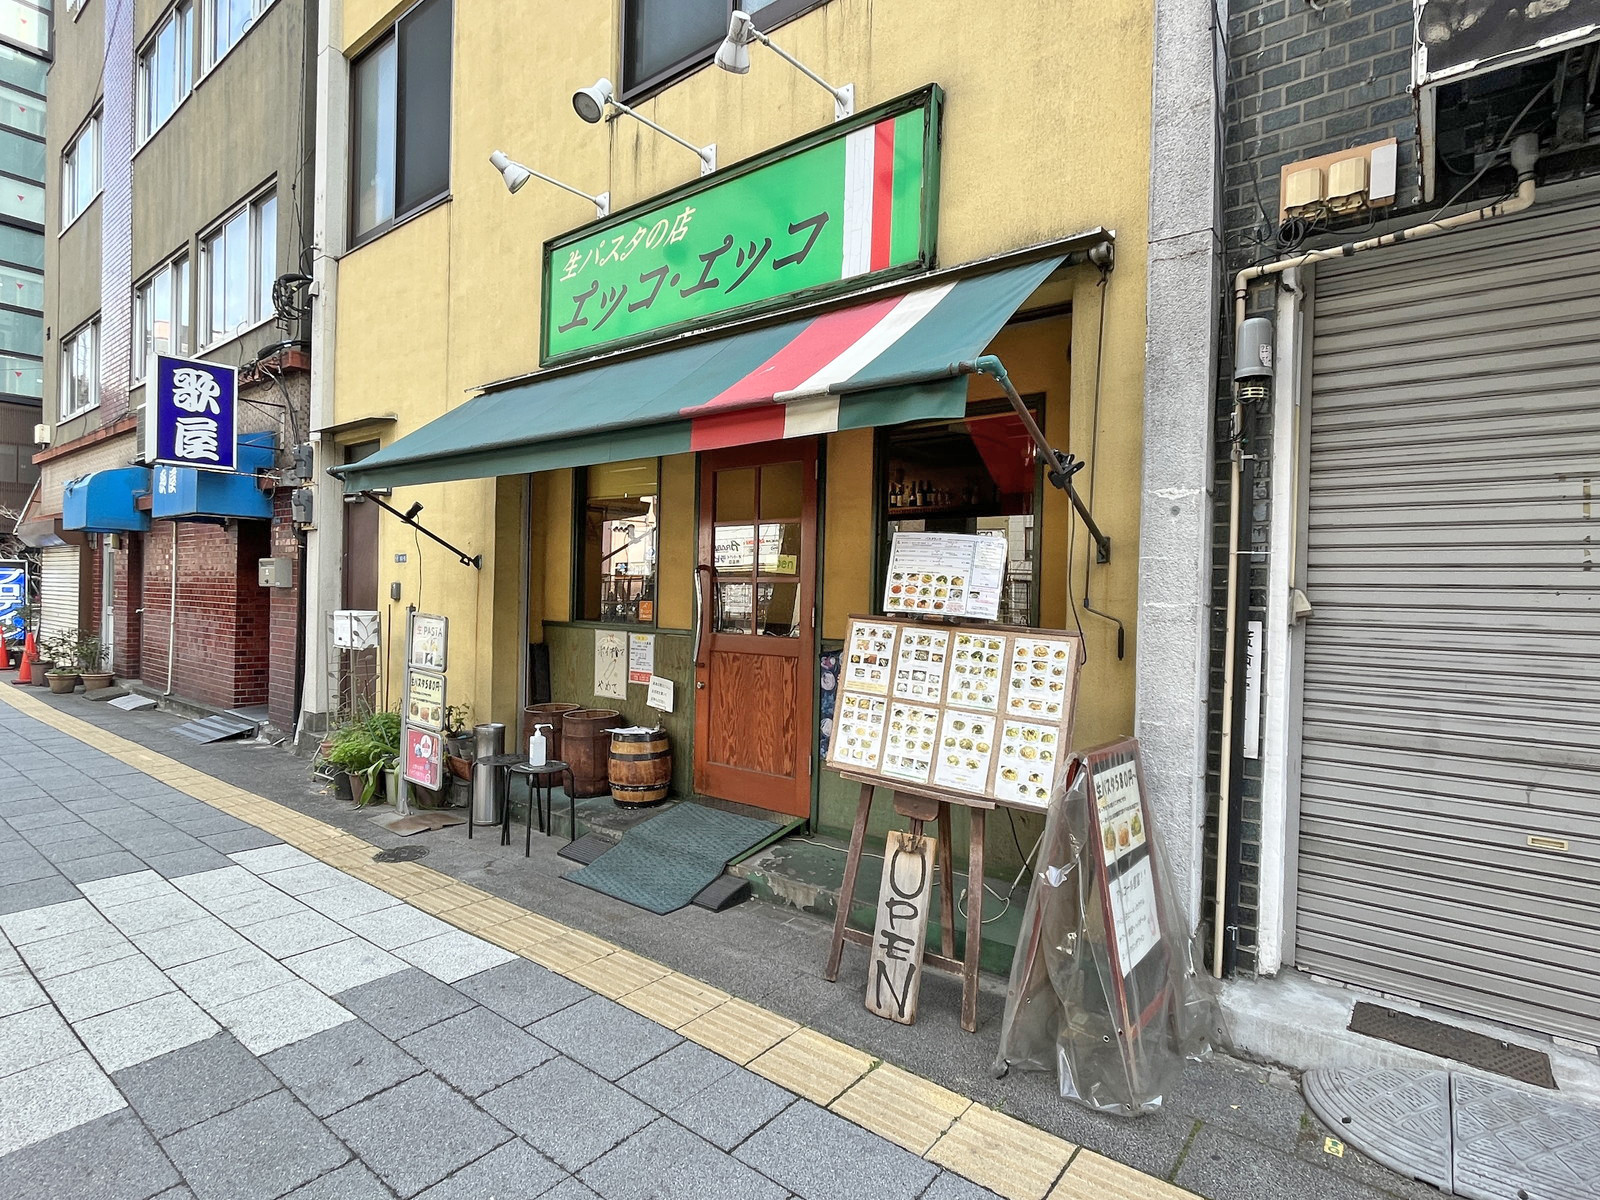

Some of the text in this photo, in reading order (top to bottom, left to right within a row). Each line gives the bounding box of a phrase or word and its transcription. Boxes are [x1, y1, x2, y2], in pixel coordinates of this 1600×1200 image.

[559, 206, 696, 282] 生パスタの店
[172, 367, 221, 461] 歌屋
[876, 848, 927, 1018] OPEN
